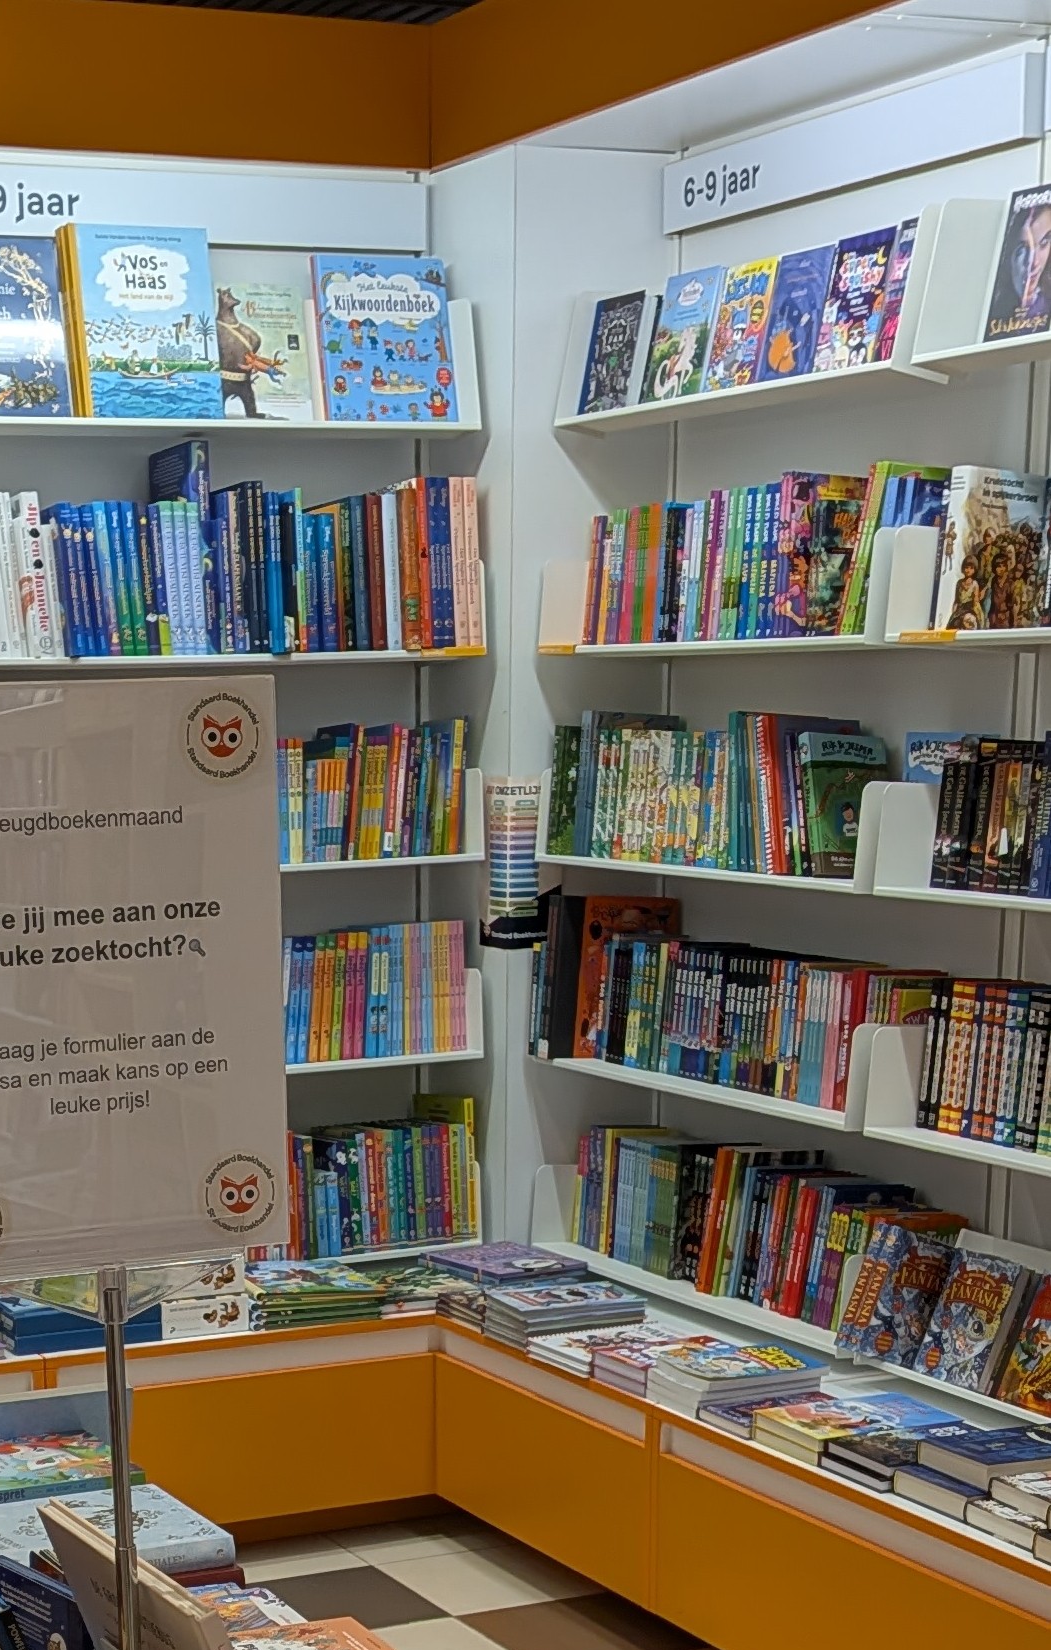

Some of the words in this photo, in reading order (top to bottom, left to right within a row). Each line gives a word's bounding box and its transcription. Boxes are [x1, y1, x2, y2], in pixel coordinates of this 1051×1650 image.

[683, 170, 717, 208] 6-9
[720, 162, 762, 206] jaar
[15, 181, 80, 223] jaar
[333, 294, 435, 316] Kijkwoordenboek
[187, 692, 222, 722] Standaard
[222, 692, 260, 726] Boekhandel
[186, 746, 219, 778] Standaard
[219, 750, 258, 779] Boekhandel
[23, 906, 45, 935] jij
[53, 906, 105, 928] mee
[112, 903, 156, 924] aan
[164, 900, 222, 920] onze
[51, 934, 186, 964] zoektocht?
[39, 1041, 58, 1062] je
[63, 1033, 147, 1056] formulier
[151, 1029, 186, 1049] aan
[191, 1027, 216, 1045] de
[28, 1072, 52, 1088] en
[58, 1065, 111, 1085] maak
[115, 1062, 160, 1080] kans
[165, 1060, 189, 1079] op
[194, 1057, 229, 1074] een
[50, 1095, 101, 1116] leuke
[106, 1090, 151, 1115] prijs!
[855, 1265, 889, 1325] FANTASIA
[950, 1280, 1001, 1310] FANTASIA
